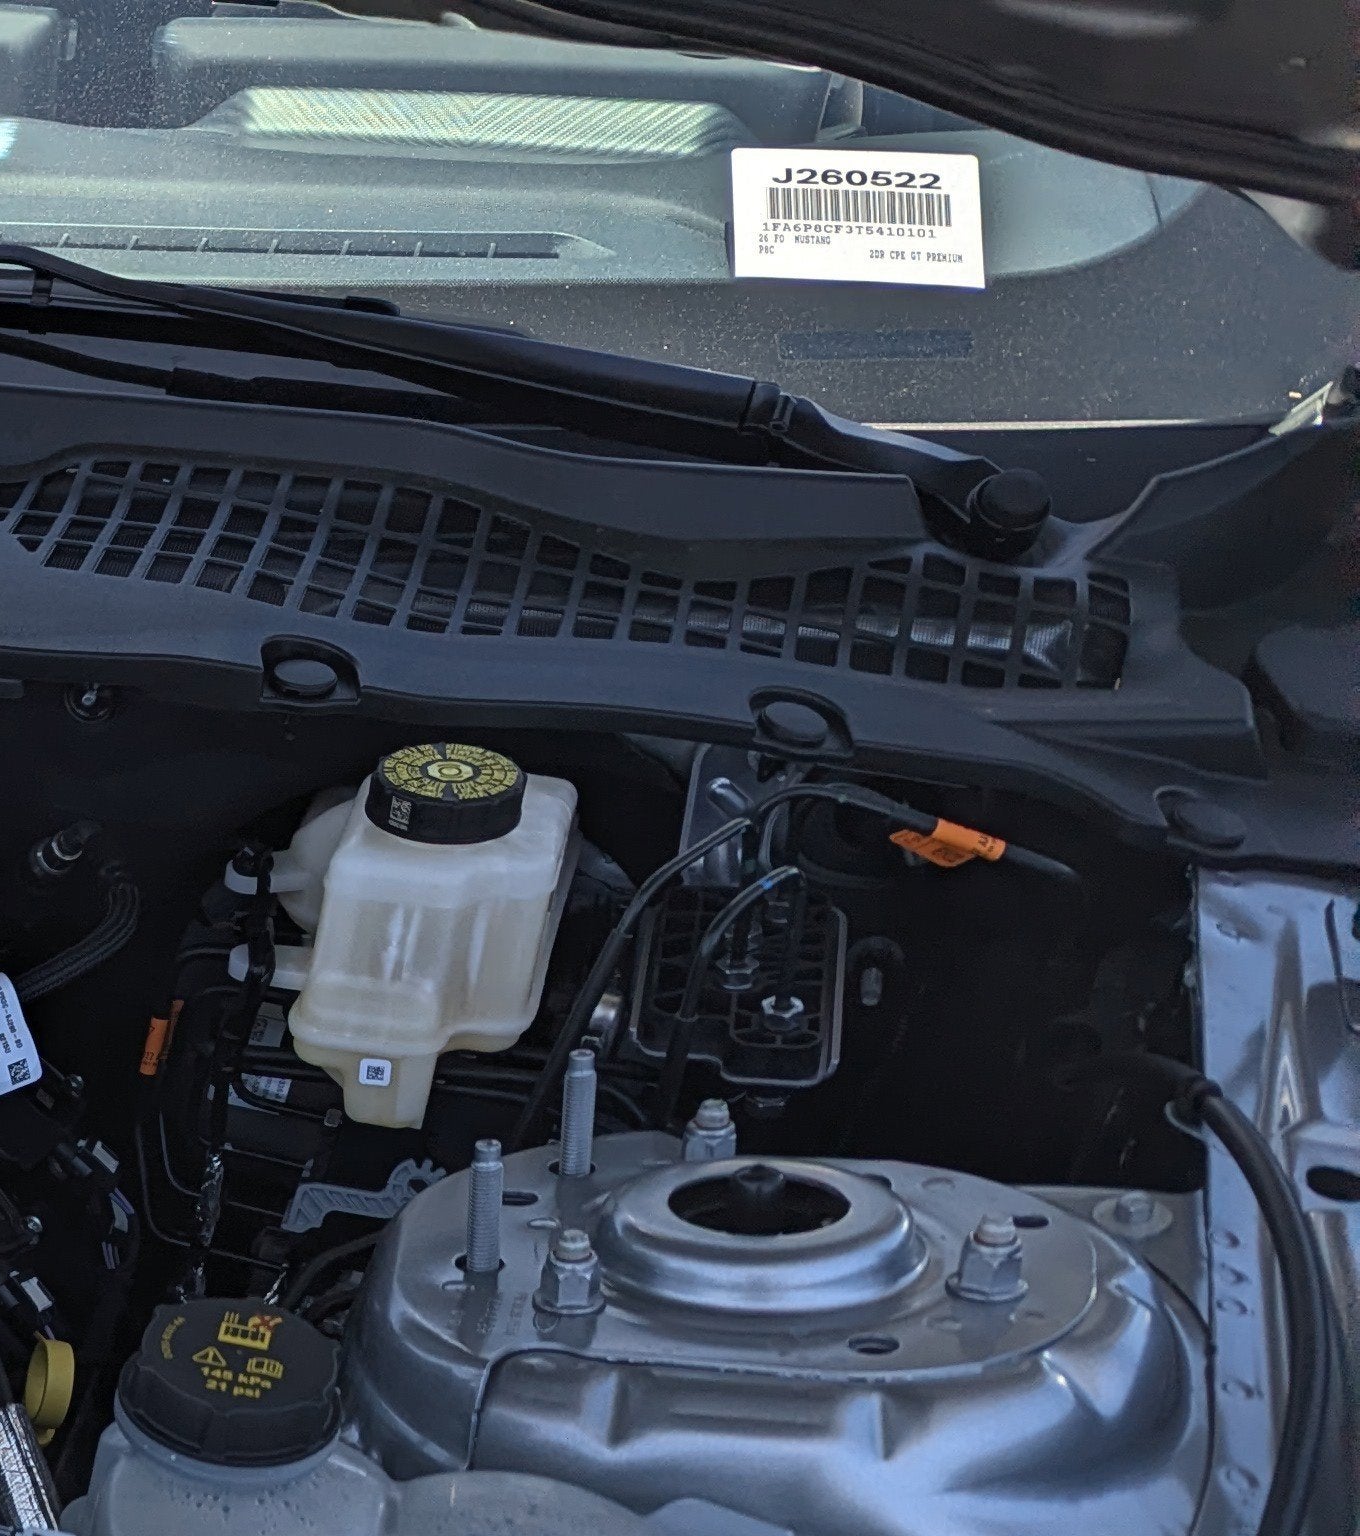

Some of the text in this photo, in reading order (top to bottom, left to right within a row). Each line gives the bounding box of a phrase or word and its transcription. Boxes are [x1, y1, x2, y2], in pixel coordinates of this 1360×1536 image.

[772, 167, 942, 190] J260522
[763, 222, 936, 239] 1FA6P8CF3T5410101
[759, 234, 769, 242] 26
[795, 235, 831, 245] MUSTANG
[759, 245, 775, 254] P8C
[870, 250, 963, 263] 2DR CPE GT PREMIUM
